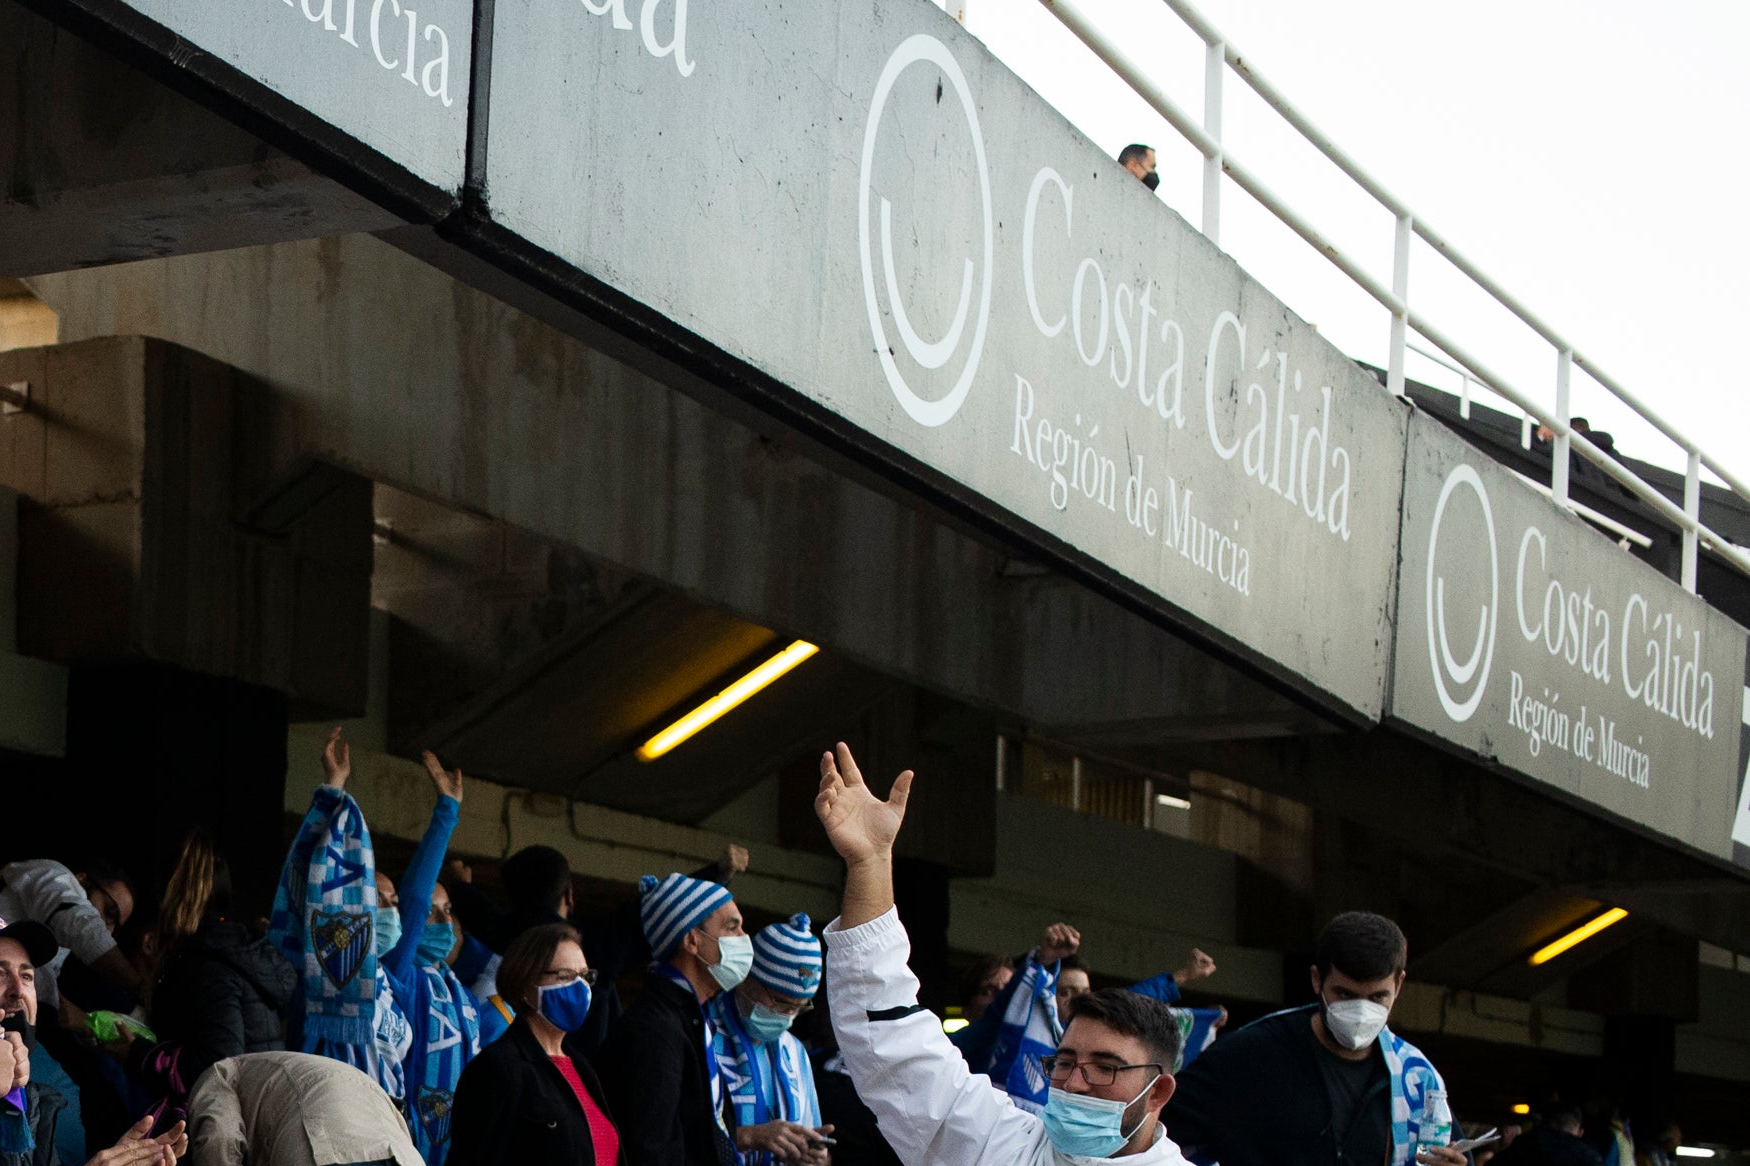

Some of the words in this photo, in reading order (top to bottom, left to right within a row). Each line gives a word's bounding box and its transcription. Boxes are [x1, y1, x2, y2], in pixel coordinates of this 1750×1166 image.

[1023, 167, 1186, 429] Costa
[1205, 311, 1351, 541] Cálida
[1010, 373, 1117, 511] Región
[1125, 455, 1159, 538] de
[1166, 477, 1250, 597] Murcia
[1508, 670, 1570, 757] Región
[1574, 705, 1595, 762] de
[1597, 715, 1650, 789] Murcia
[1516, 526, 1611, 684] Costa
[1621, 594, 1714, 739] Cálida
